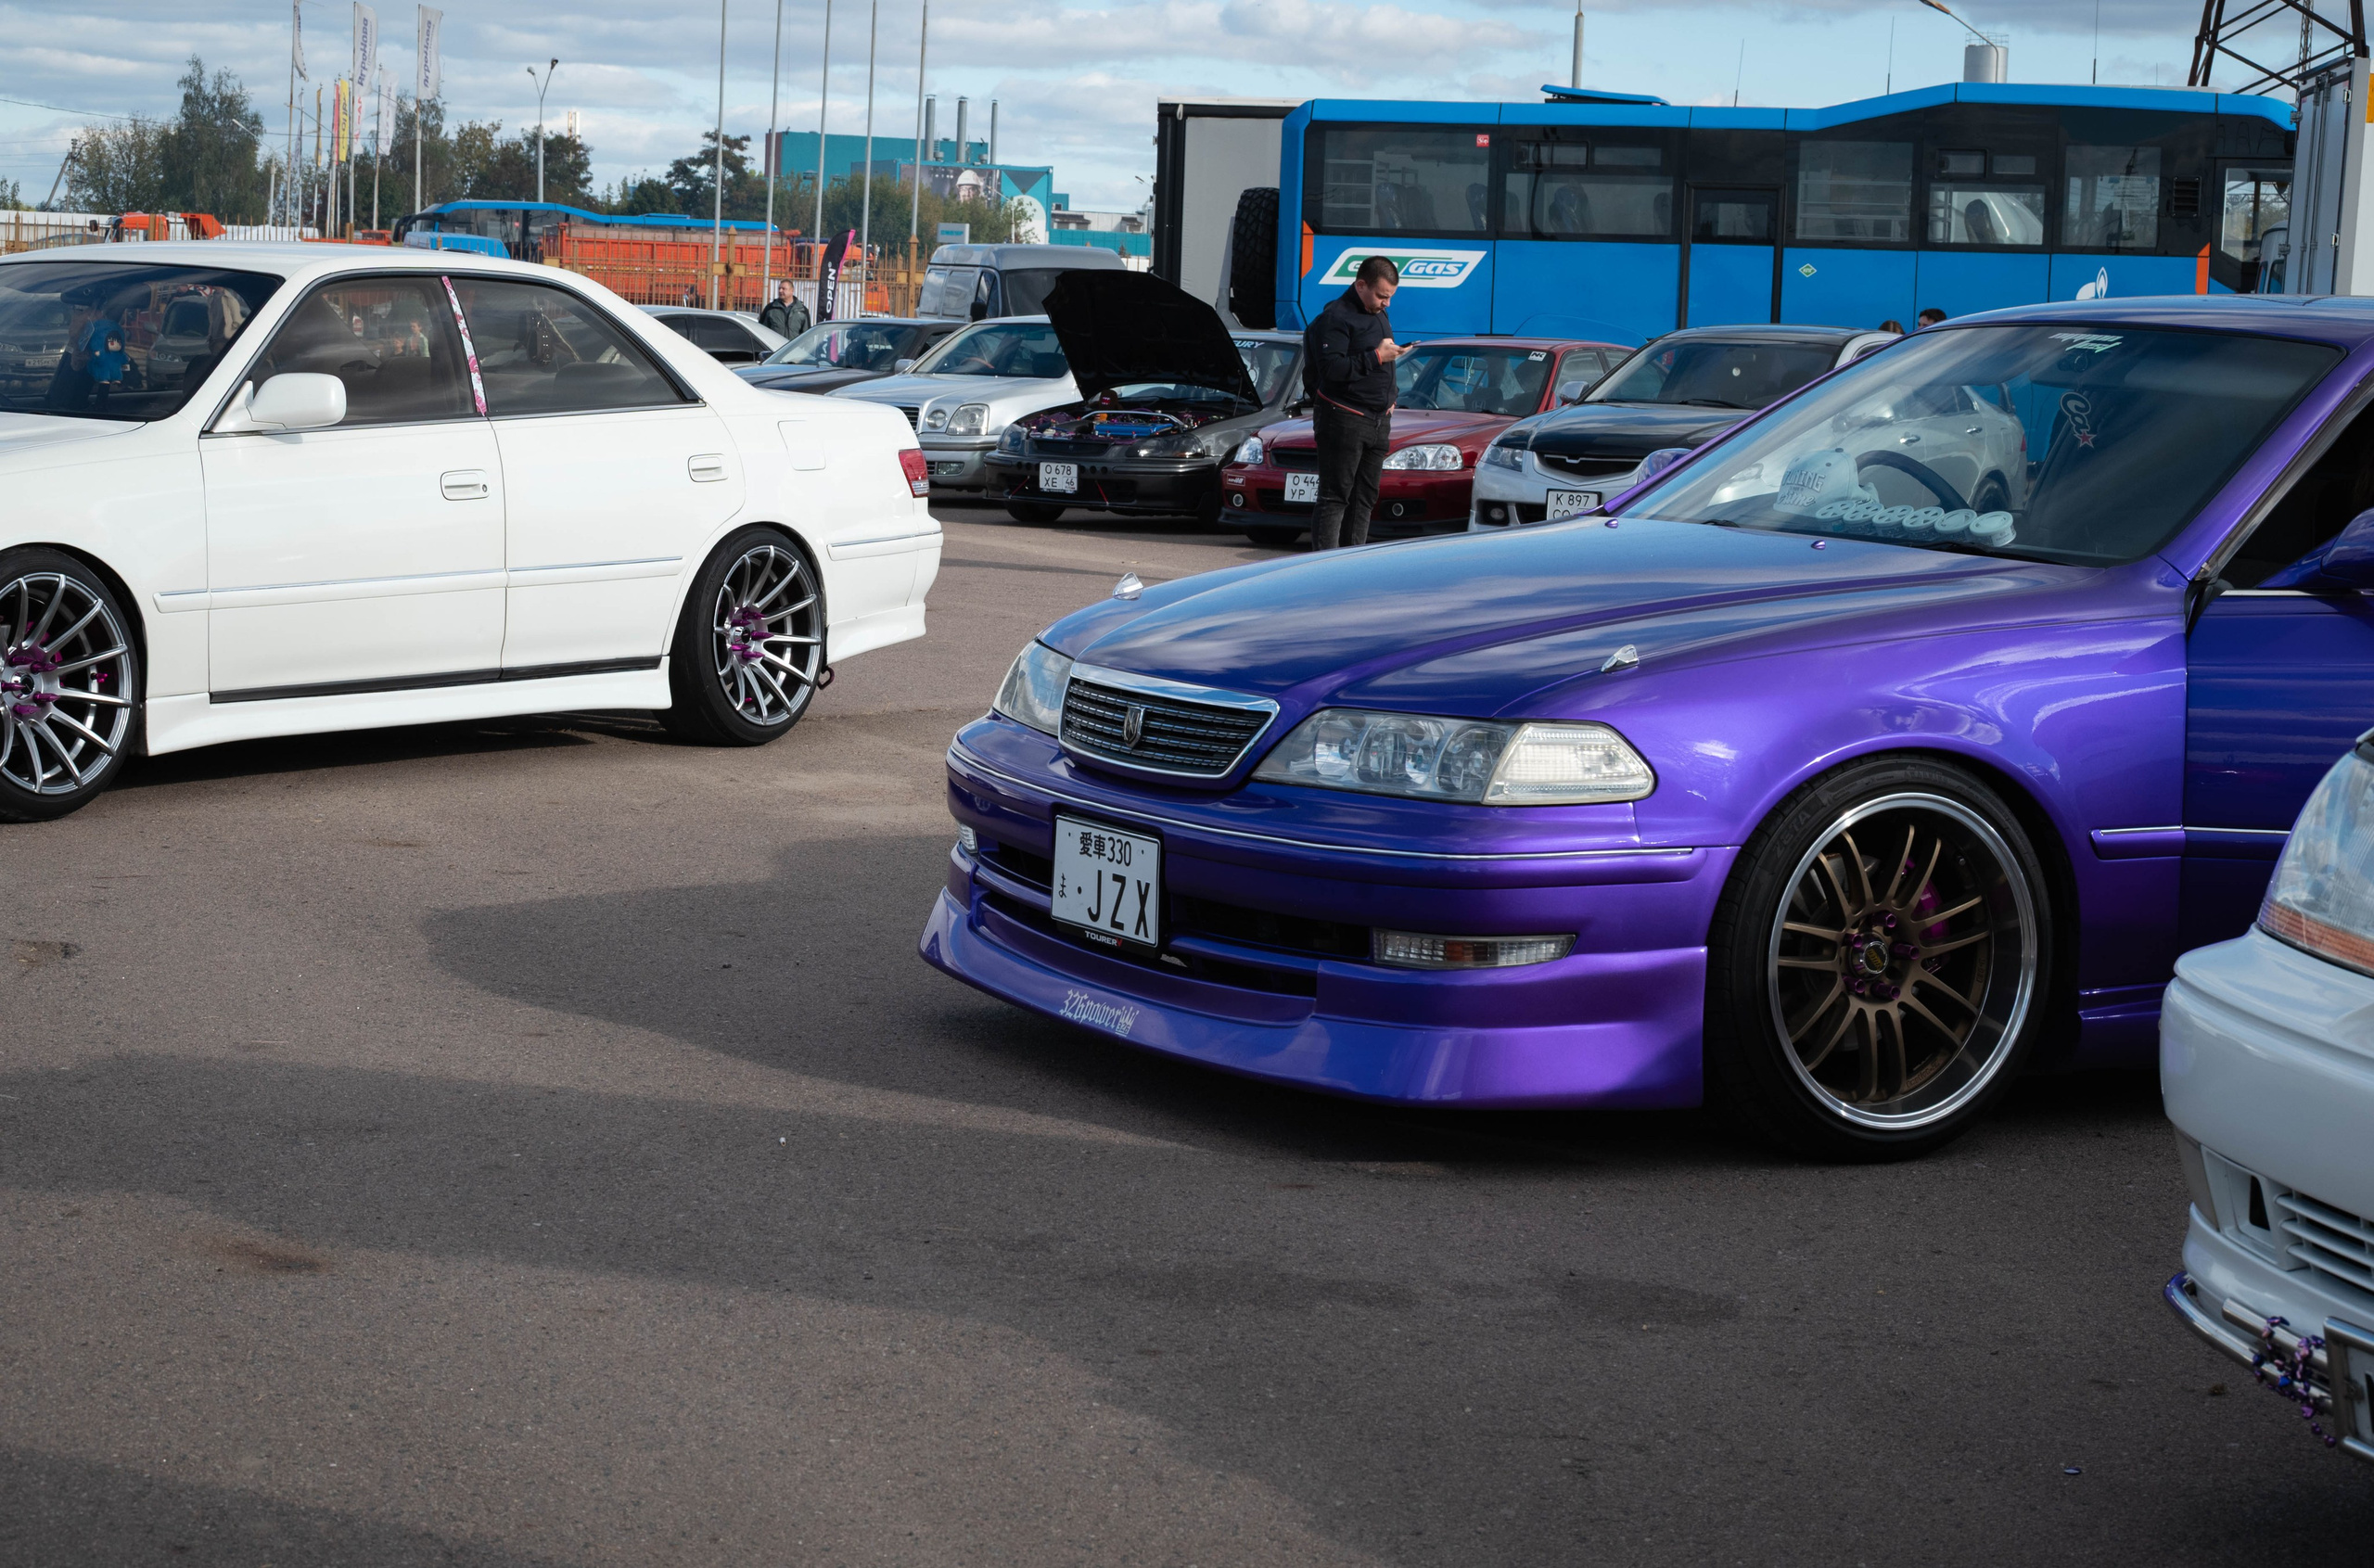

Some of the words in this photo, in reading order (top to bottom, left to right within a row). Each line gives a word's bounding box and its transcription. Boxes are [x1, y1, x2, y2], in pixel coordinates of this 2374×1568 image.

[1054, 465, 1072, 476] 678
[1065, 478, 1075, 487] 46
[1781, 469, 1826, 493] TUNING
[1567, 494, 1589, 506] 897
[1079, 831, 1132, 867] 愛車330
